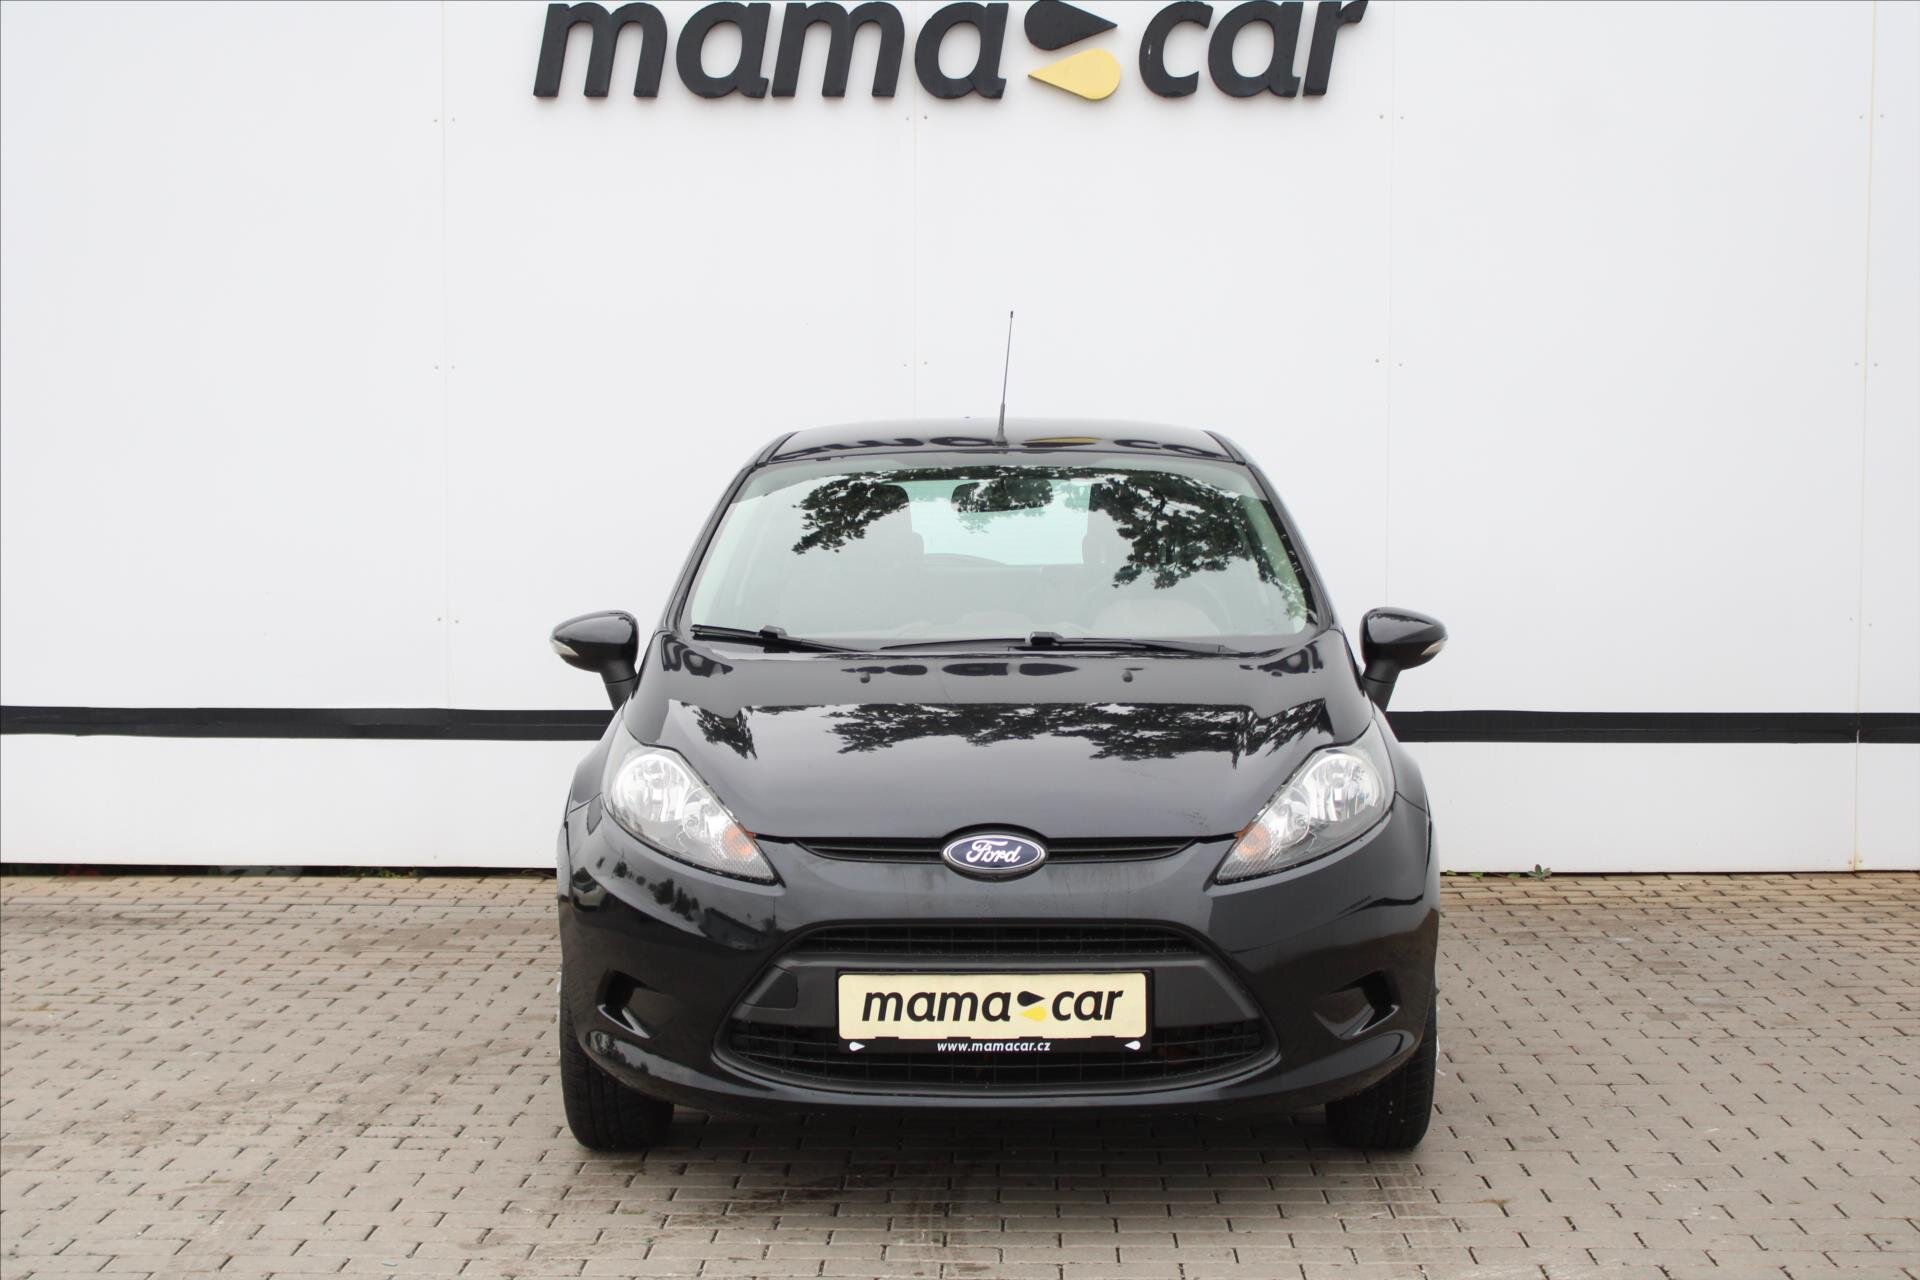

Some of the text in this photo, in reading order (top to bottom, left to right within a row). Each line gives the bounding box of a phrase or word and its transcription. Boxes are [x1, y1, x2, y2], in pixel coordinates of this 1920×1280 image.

[533, 0, 1369, 99] mama car
[966, 840, 1022, 863] Ford
[861, 990, 1124, 1022] mama car
[937, 1040, 1051, 1052] www.mamacar.cz
